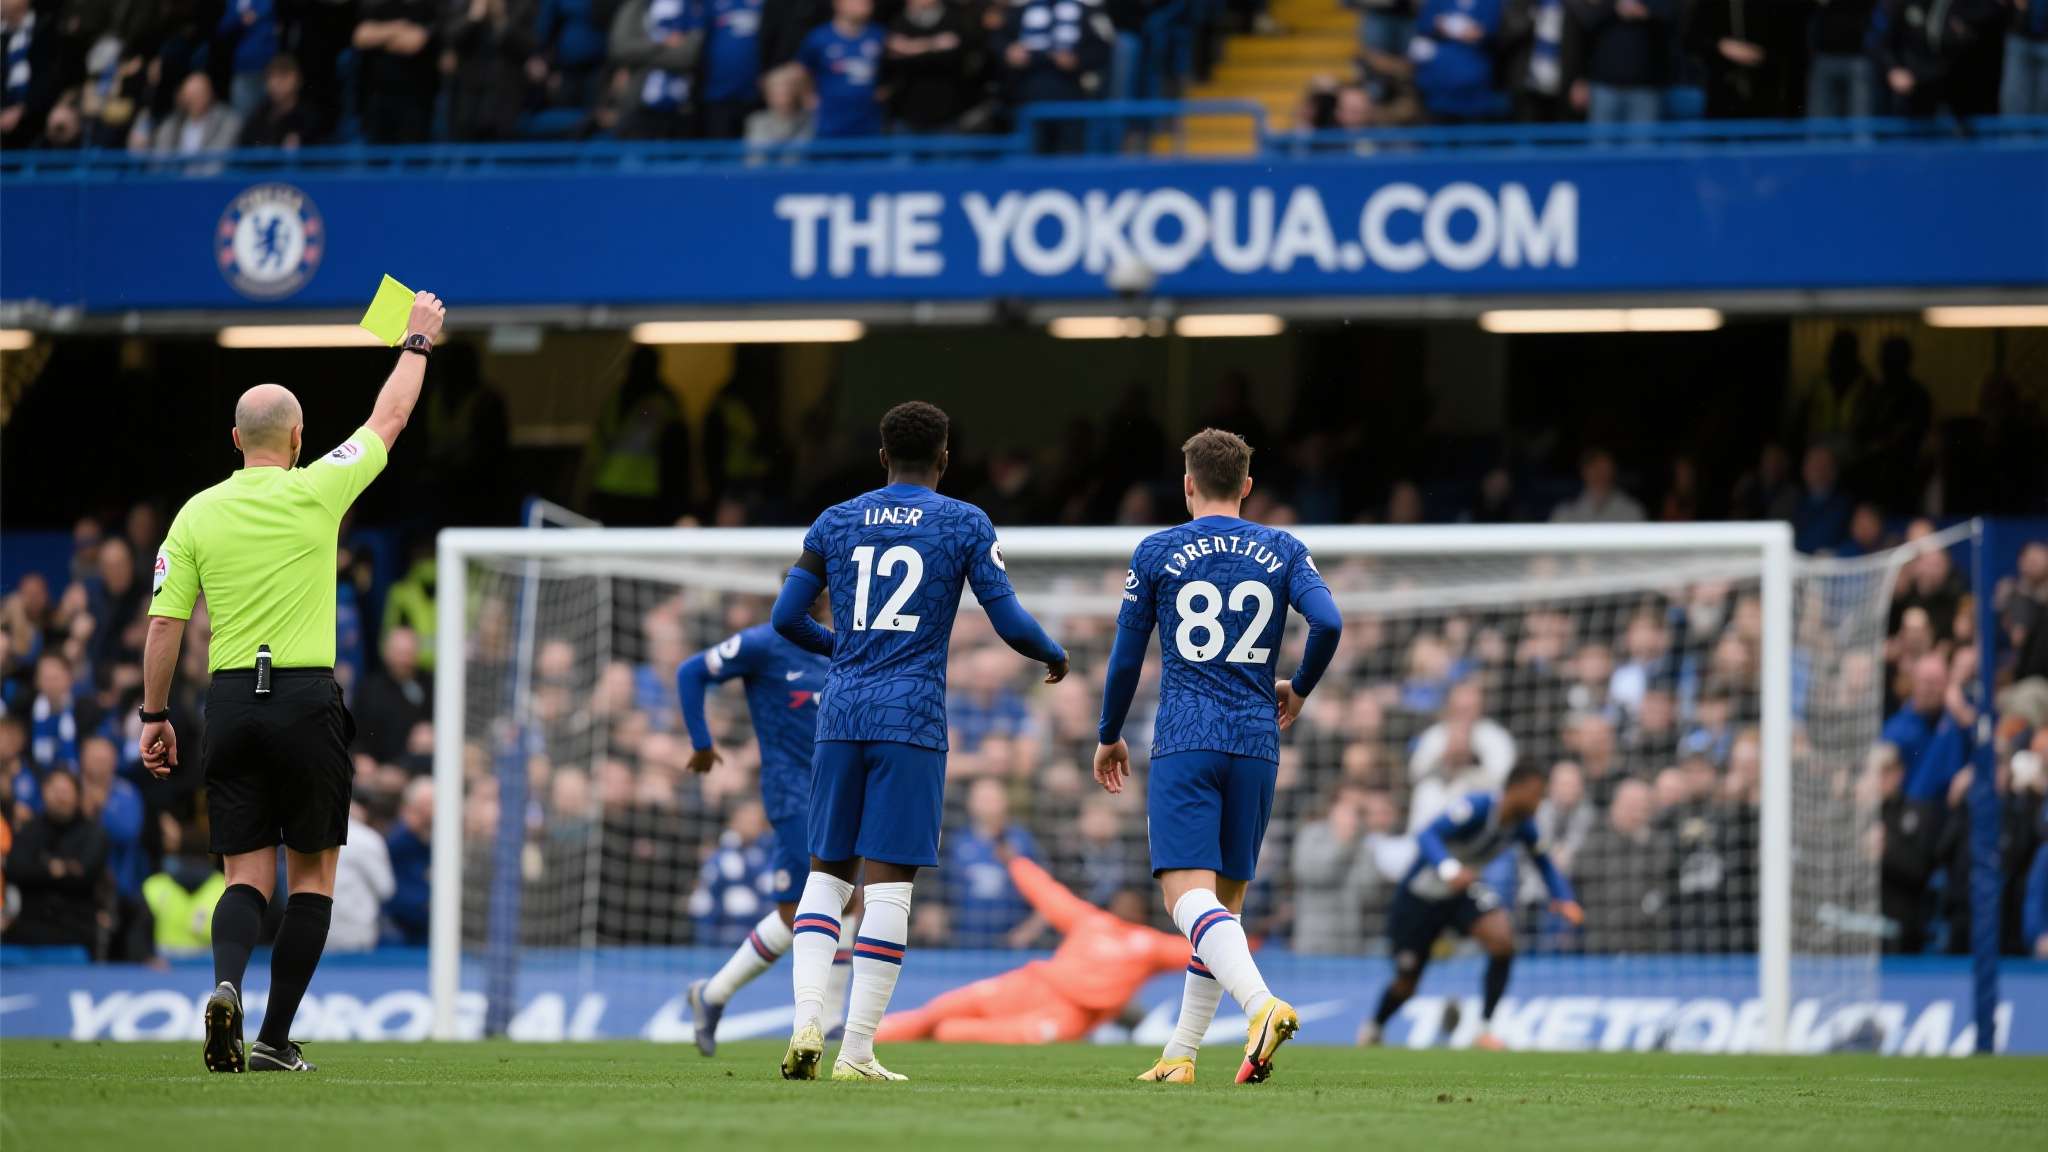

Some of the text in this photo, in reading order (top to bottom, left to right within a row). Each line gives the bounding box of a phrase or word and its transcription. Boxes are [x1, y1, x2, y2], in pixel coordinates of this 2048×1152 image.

[776, 181, 1579, 278] THE YOKOUA.COM
[850, 545, 924, 632] 12
[1175, 580, 1274, 664] 82
